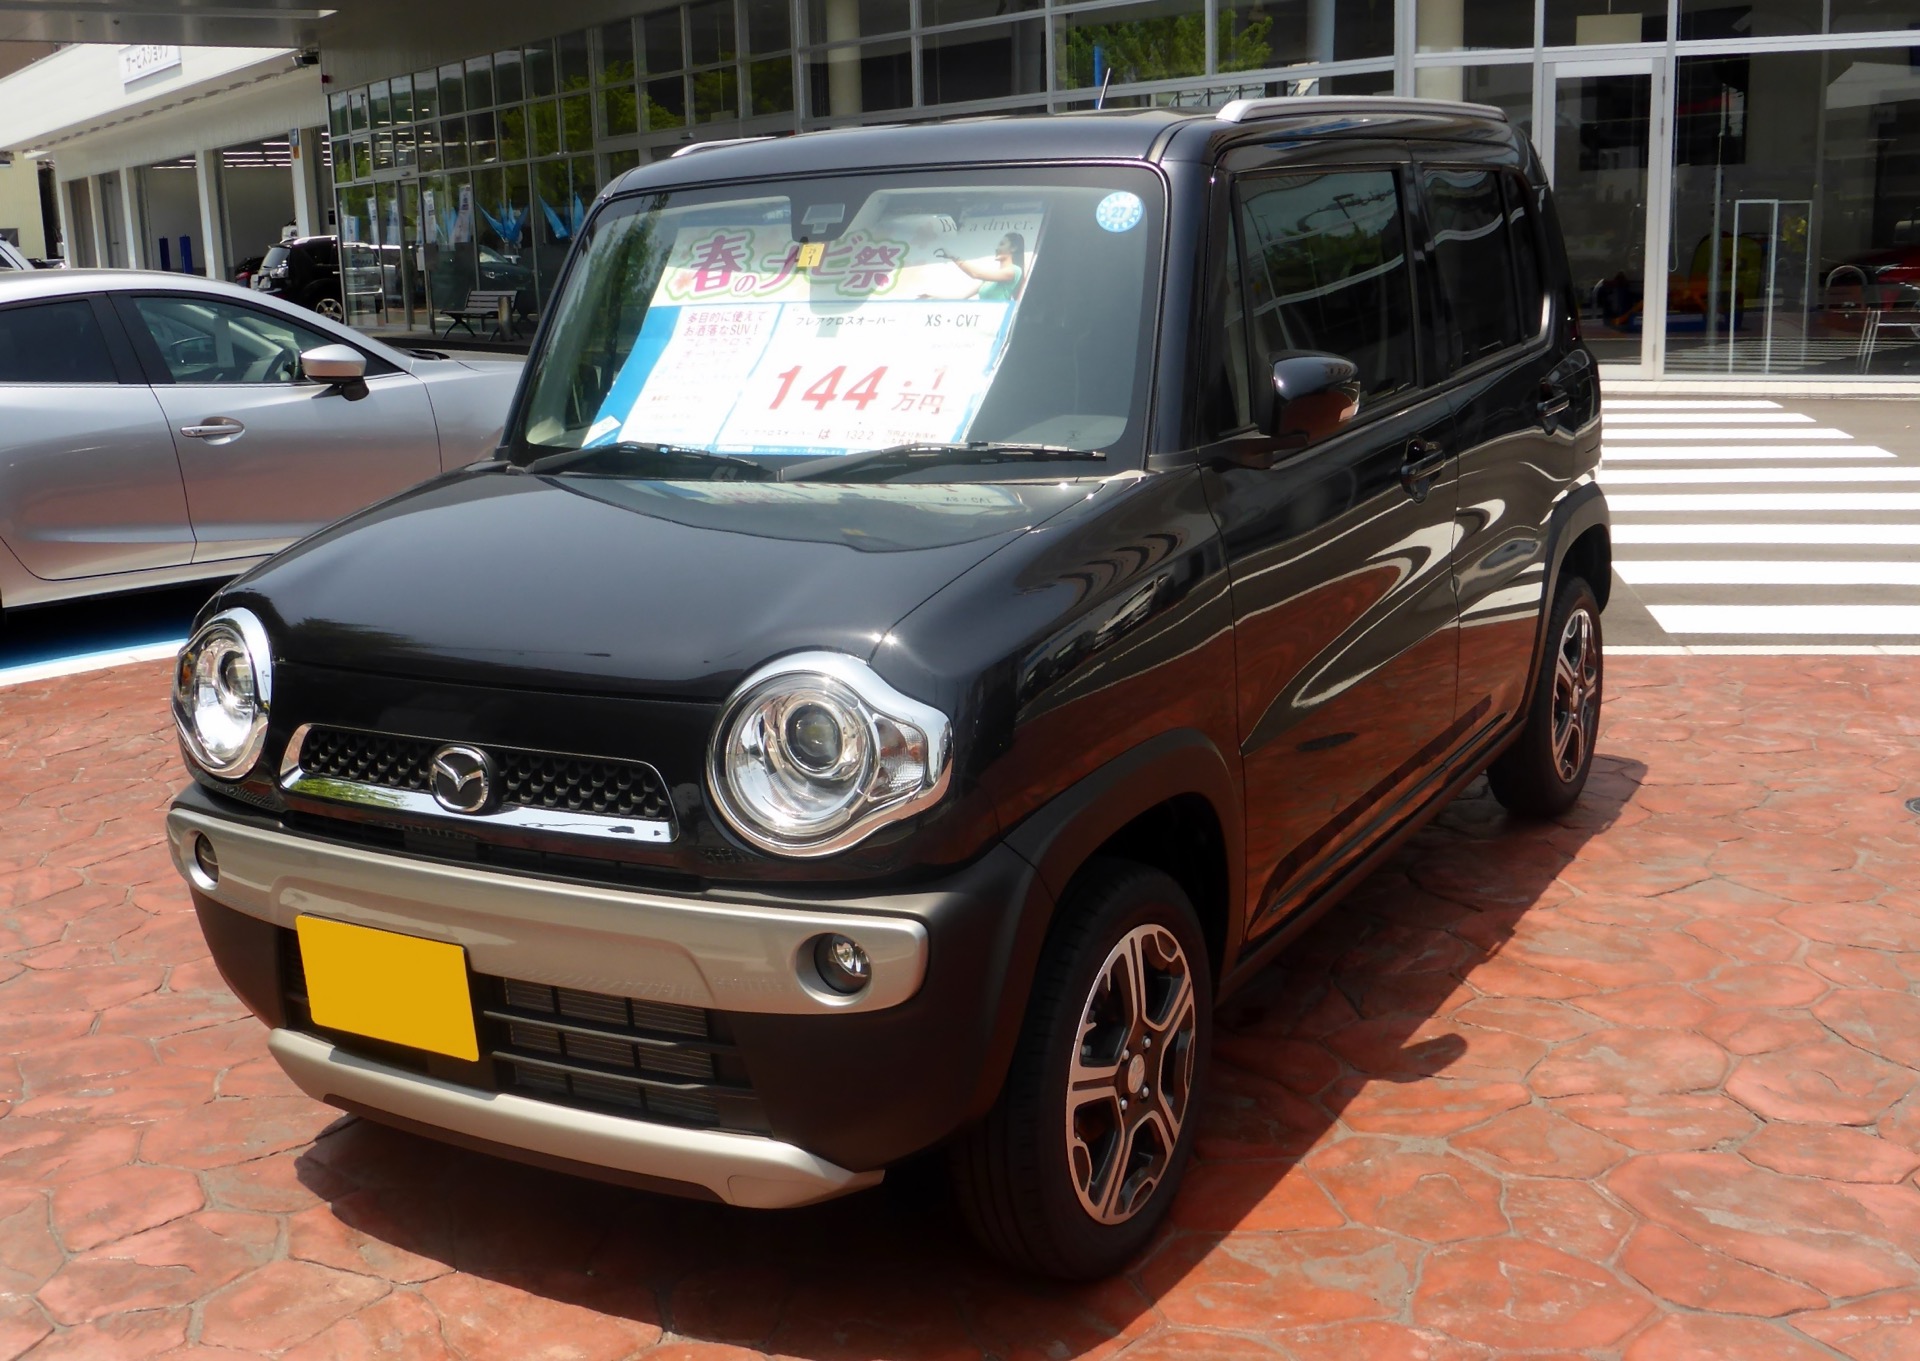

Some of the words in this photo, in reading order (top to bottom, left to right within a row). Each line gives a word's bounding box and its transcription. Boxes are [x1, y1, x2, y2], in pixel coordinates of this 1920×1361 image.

[690, 234, 901, 293] 春のナビ祭
[890, 392, 945, 414] 万円
